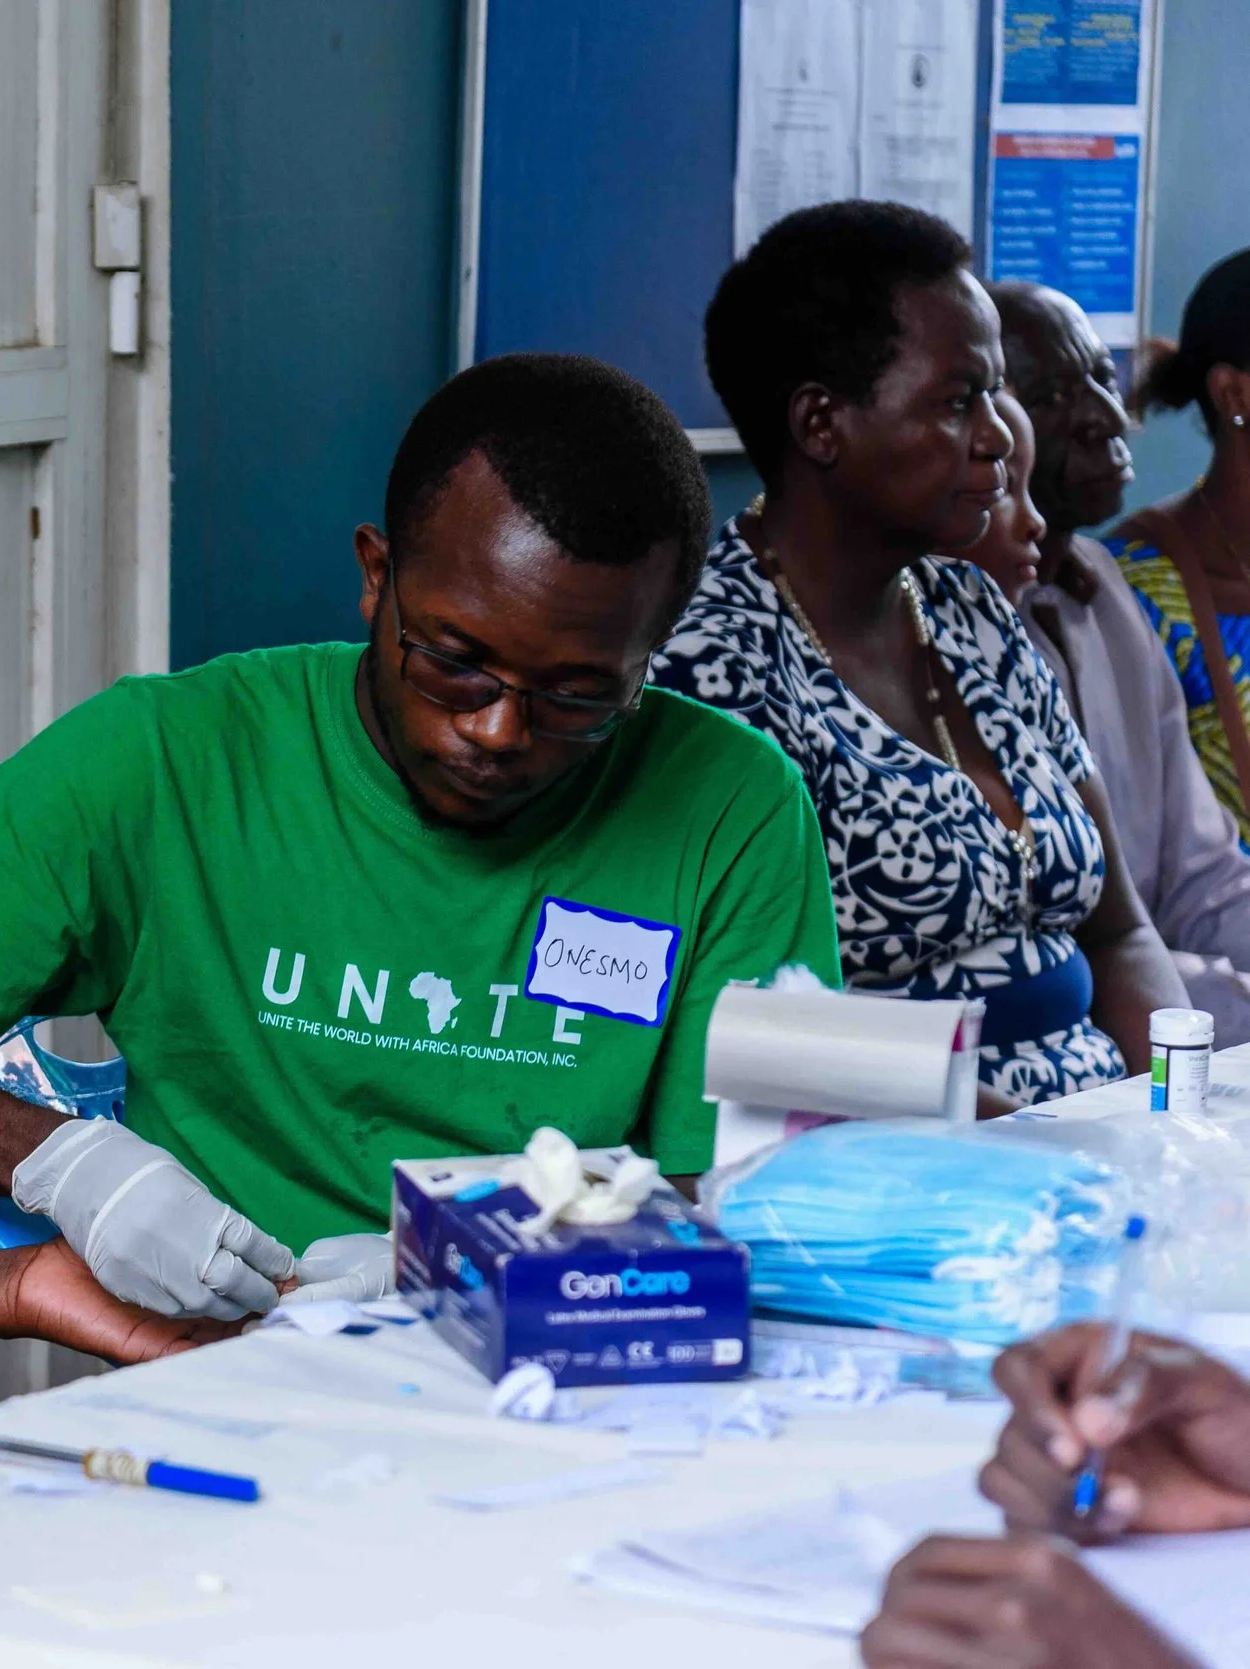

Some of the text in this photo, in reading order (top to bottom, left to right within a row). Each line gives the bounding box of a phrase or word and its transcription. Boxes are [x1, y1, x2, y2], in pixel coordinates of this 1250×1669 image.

[544, 938, 648, 984] ONESMO
[258, 1010, 578, 1068] UNITE THE WORLD WITH AFRICA FOUNDATION, INC.
